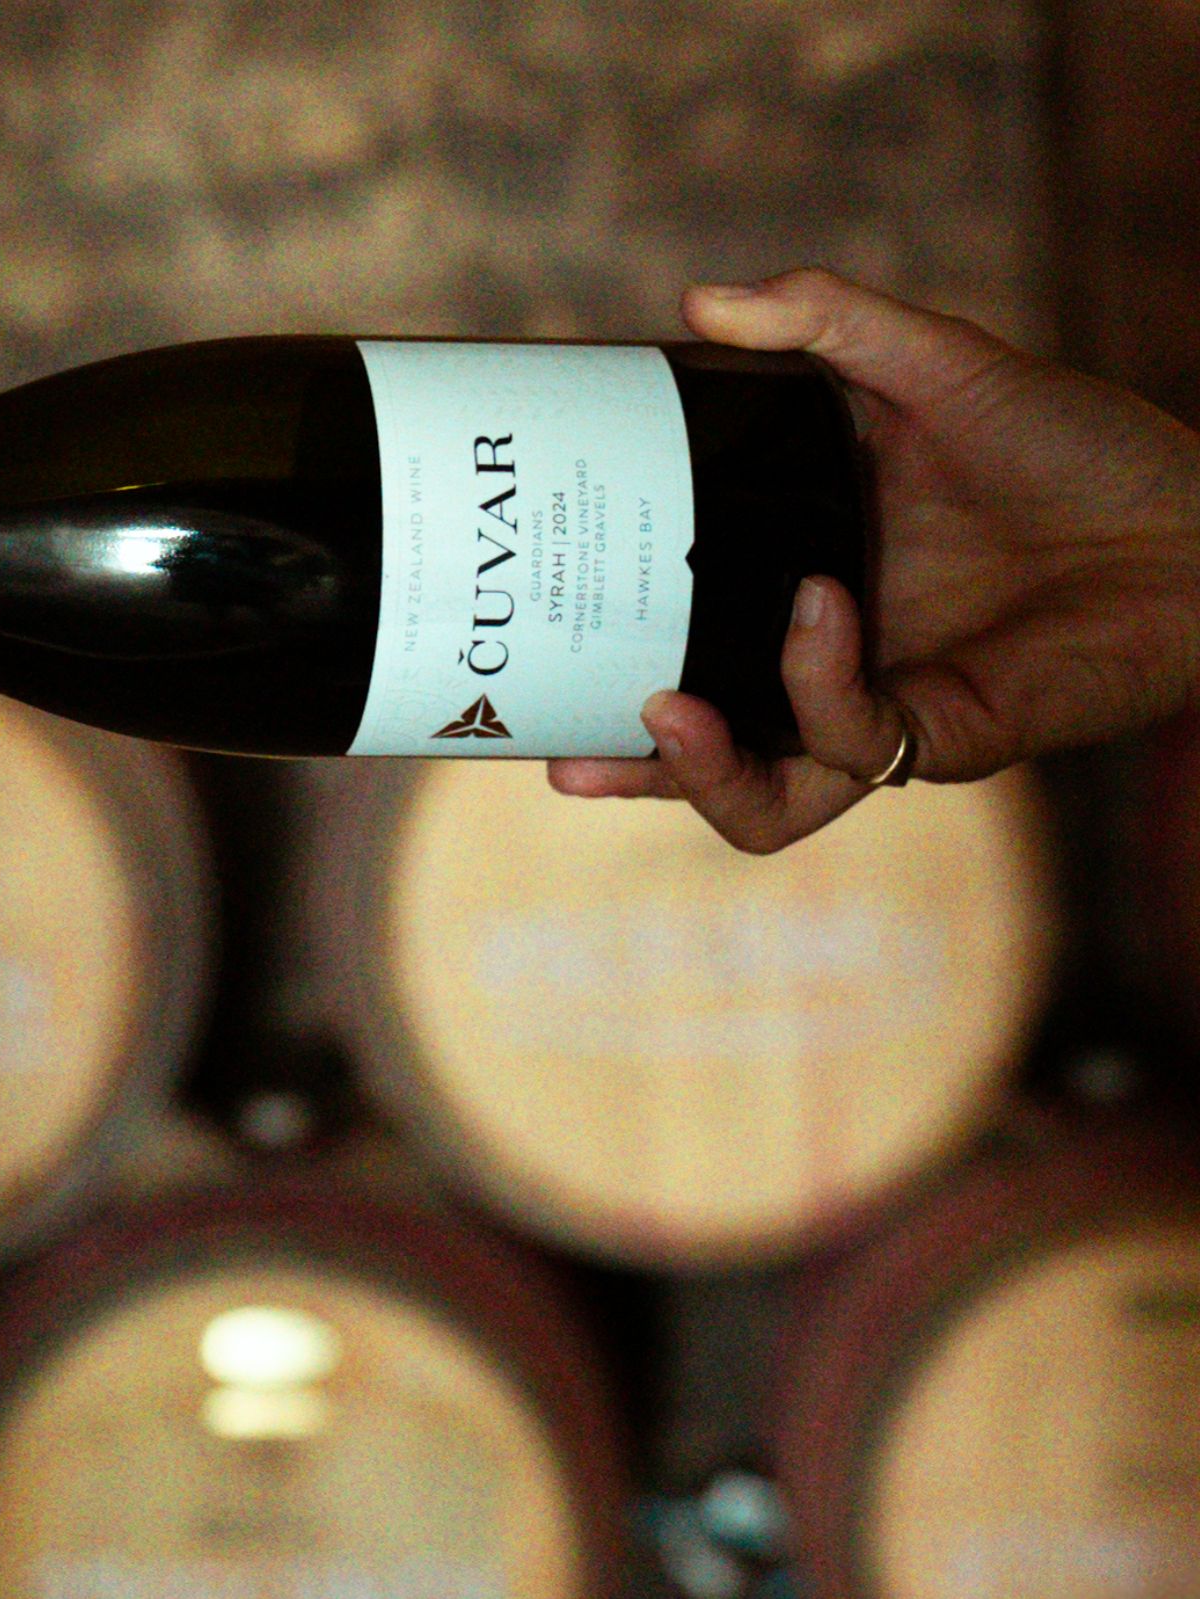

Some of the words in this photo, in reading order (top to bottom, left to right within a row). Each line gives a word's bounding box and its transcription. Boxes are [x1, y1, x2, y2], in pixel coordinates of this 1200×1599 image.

[407, 455, 422, 504] WINE
[551, 490, 567, 536] 2024
[574, 458, 590, 535] VINEYARD
[638, 496, 652, 532] BAY
[592, 484, 607, 552] GRAVELS
[408, 513, 423, 604] ZEALAND
[457, 432, 518, 676] ČUVAR
[529, 510, 544, 602] GUARDIANS
[548, 553, 566, 623] SYRAH
[635, 541, 652, 621] HAWKES
[570, 541, 589, 653] CORNERSTONE
[590, 560, 606, 630] GIMBLETT
[404, 611, 419, 652] NEW
